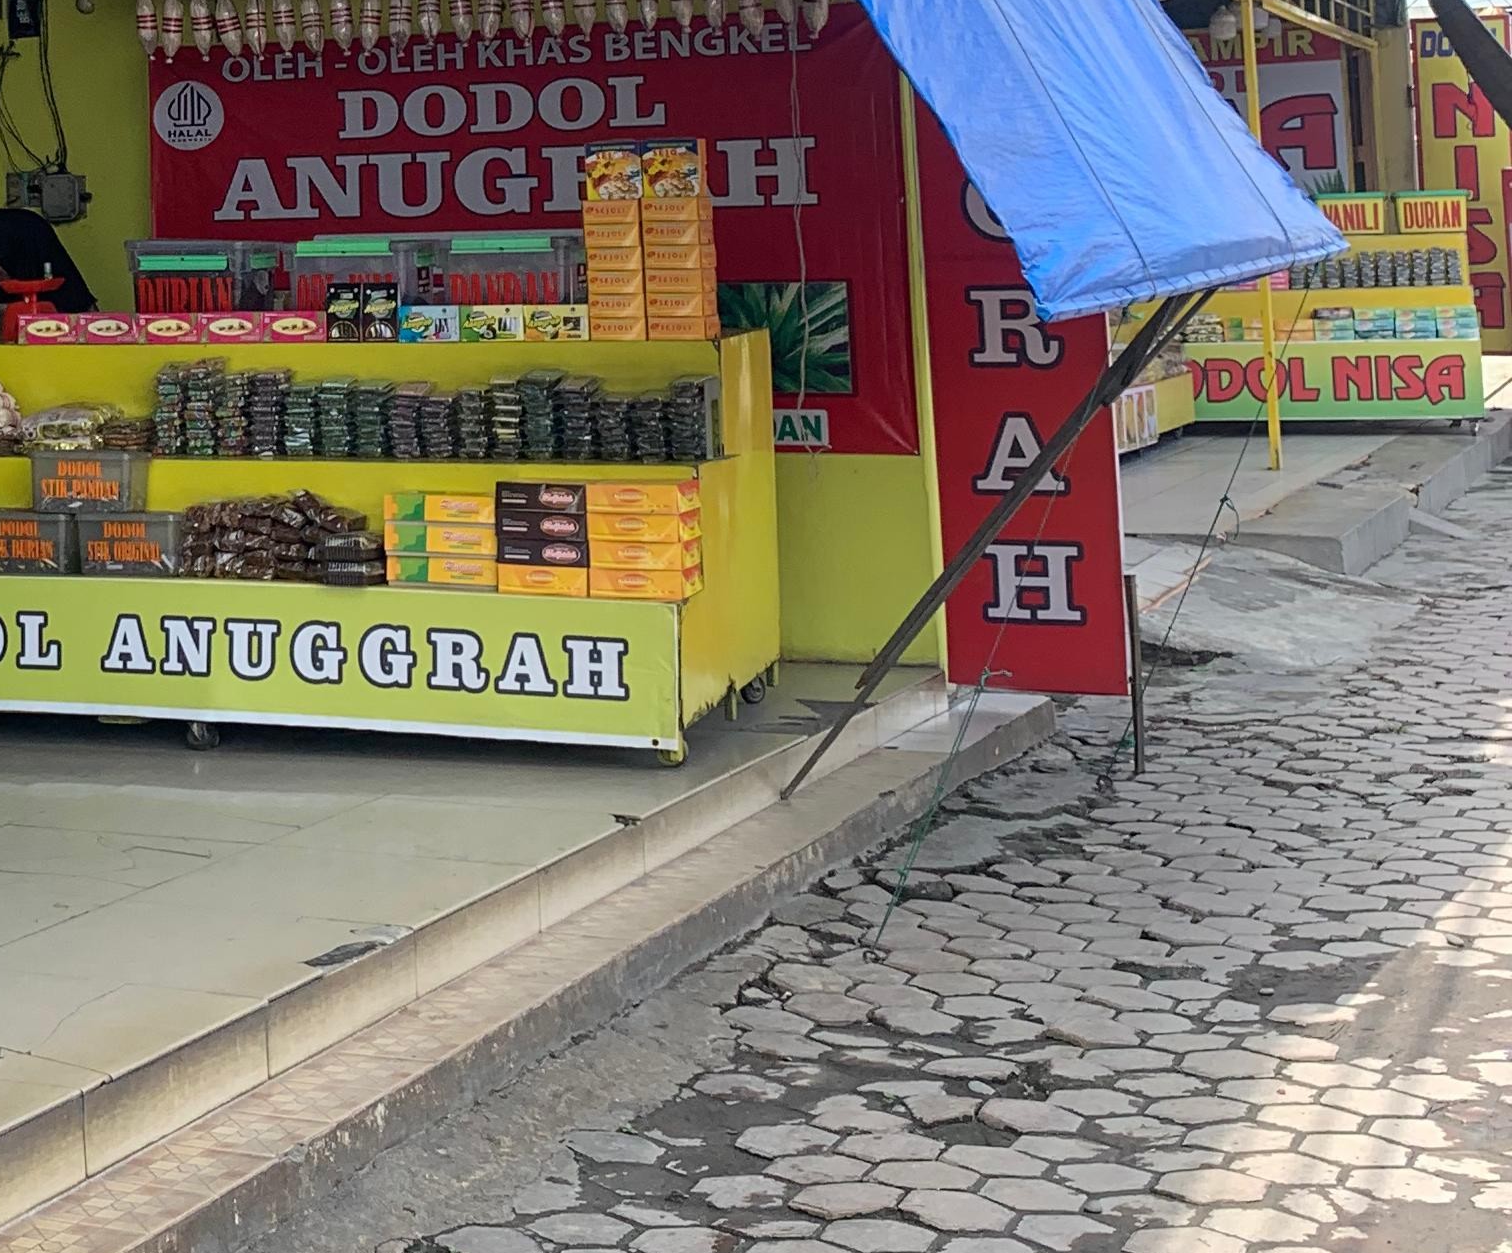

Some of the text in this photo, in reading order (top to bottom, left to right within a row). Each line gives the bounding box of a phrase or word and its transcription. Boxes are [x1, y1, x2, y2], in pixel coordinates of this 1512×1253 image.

[221, 50, 324, 83] OLEH
[357, 43, 465, 76] OLEH
[476, 34, 592, 69] KHAS
[603, 22, 813, 63] BENGKEL
[336, 75, 666, 140] DODOL
[167, 129, 213, 139] HALAL
[213, 136, 819, 221] ANUGH
[1403, 200, 1462, 229] DURIAN
[138, 276, 233, 312] DURIAN
[1191, 354, 1465, 405] DOL NISA
[774, 415, 822, 442] AN
[58, 460, 102, 477] DODOL
[41, 479, 120, 499] STIK PANDAN
[102, 613, 631, 702] ANUGGRAH
